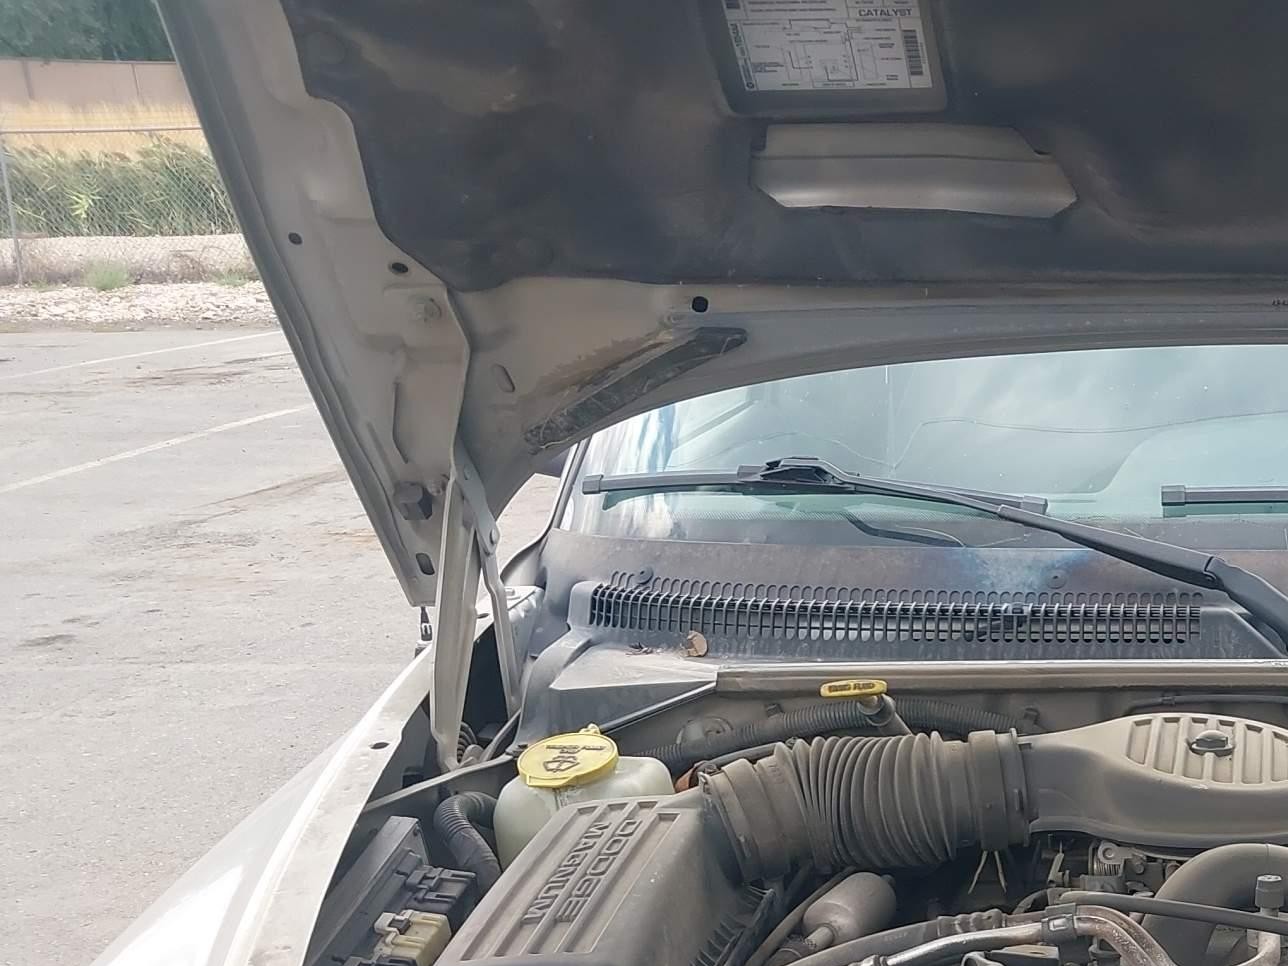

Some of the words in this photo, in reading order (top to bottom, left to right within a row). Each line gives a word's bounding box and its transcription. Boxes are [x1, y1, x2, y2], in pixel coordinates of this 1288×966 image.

[858, 8, 913, 17] CATALYST
[520, 822, 612, 923] MAGNUM
[556, 819, 643, 923] DODGE
